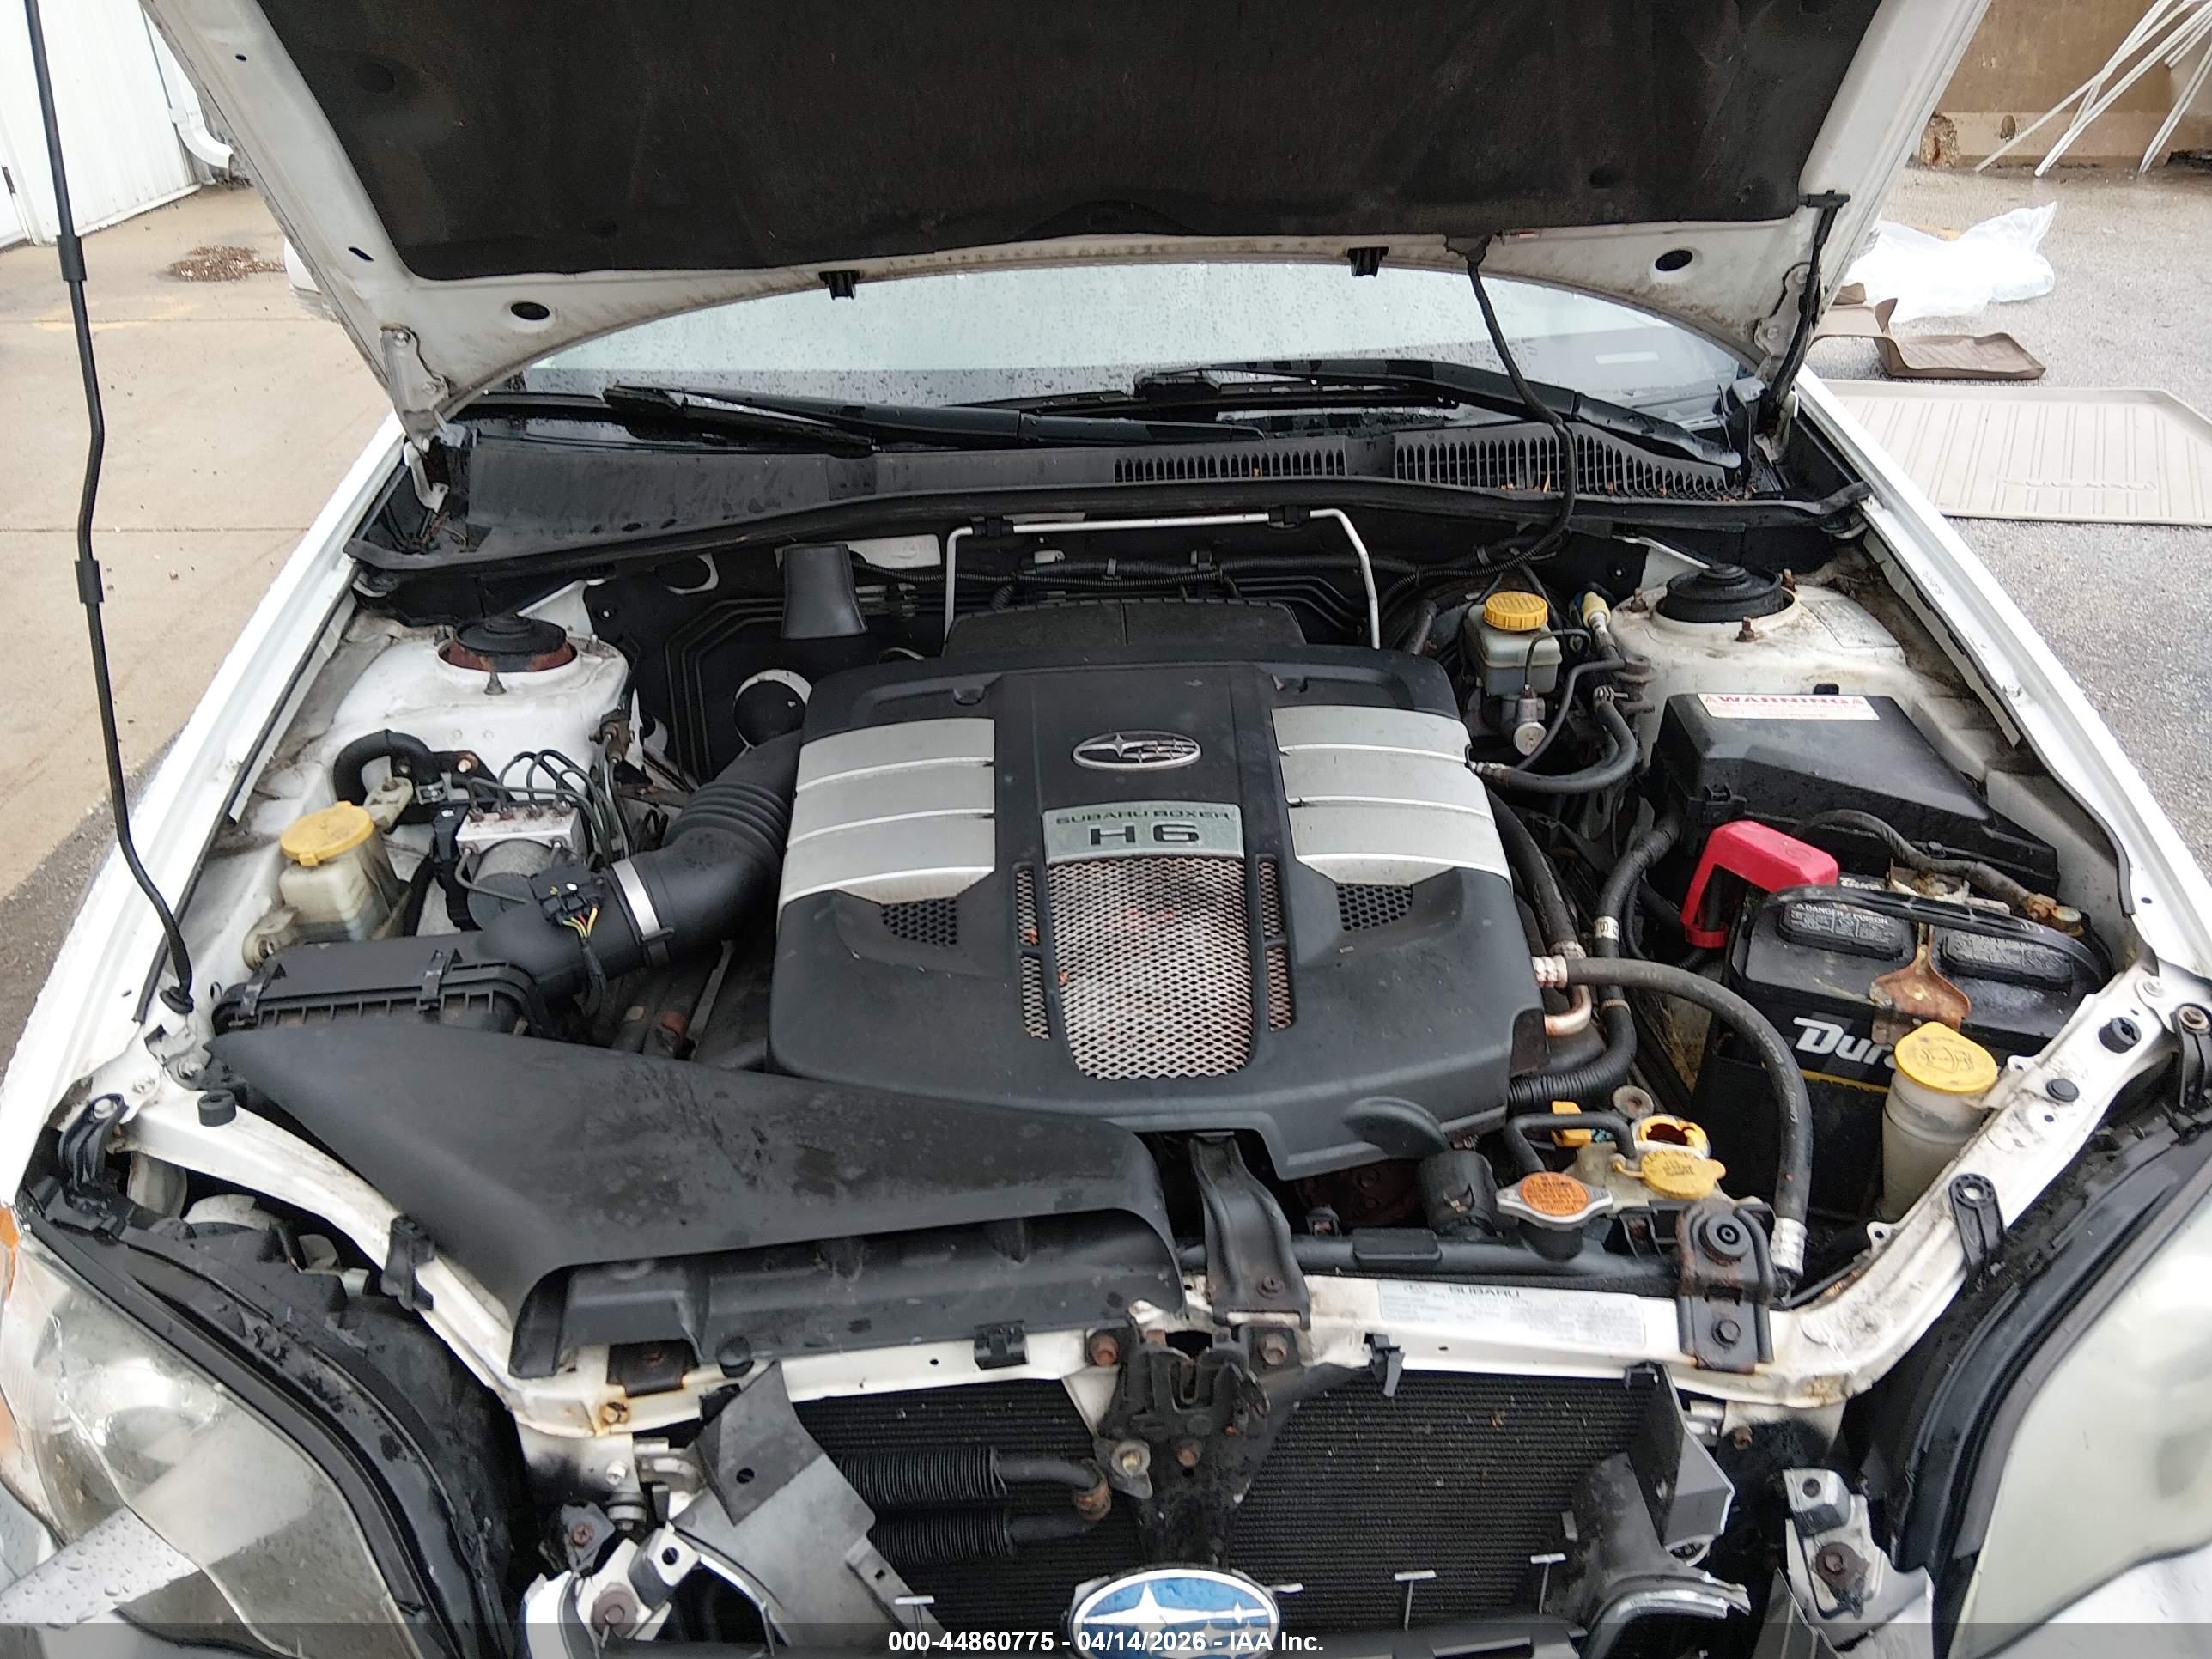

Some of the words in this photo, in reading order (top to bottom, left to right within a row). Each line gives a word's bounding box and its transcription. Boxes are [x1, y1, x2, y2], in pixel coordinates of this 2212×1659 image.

[1718, 696, 1849, 705] WARNING
[1056, 810, 1148, 824] SUBARU
[1152, 809, 1231, 820] BOXER
[1449, 1285, 1520, 1299] SUBARU
